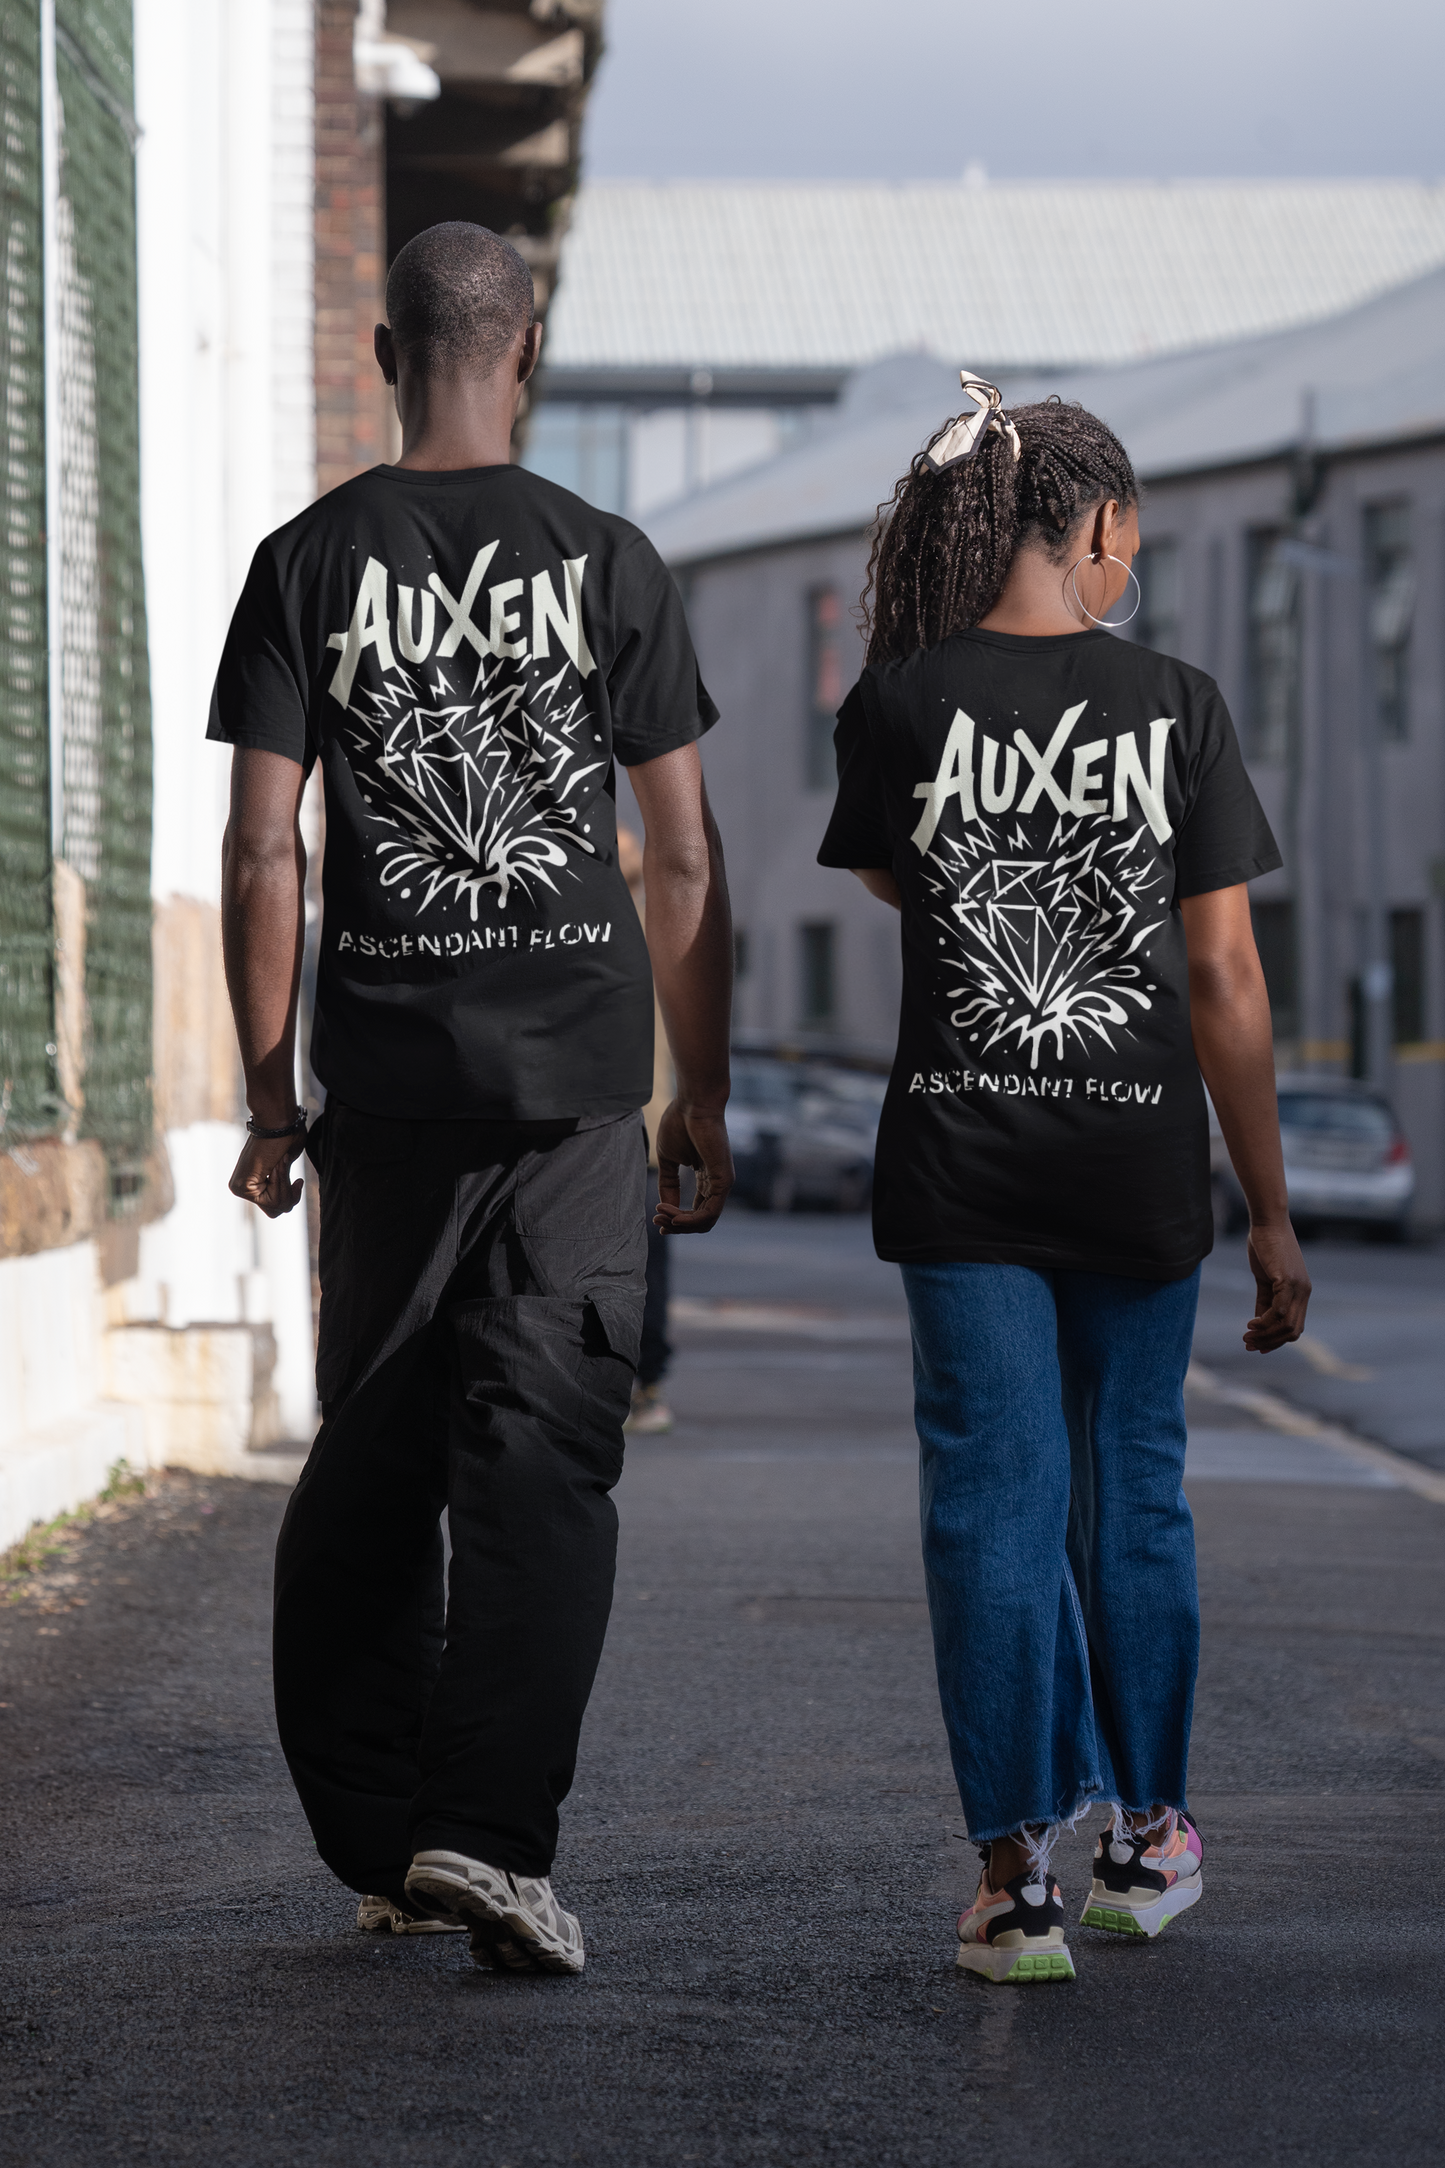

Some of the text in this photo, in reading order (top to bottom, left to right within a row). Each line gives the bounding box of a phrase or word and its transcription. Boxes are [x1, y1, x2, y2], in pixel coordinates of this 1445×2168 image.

[325, 539, 598, 709] AUXEN
[910, 700, 1176, 856] AUXEN
[338, 922, 611, 958] ASCENDANT FLOW
[908, 1070, 1163, 1104] ASCENDANT FLOW
